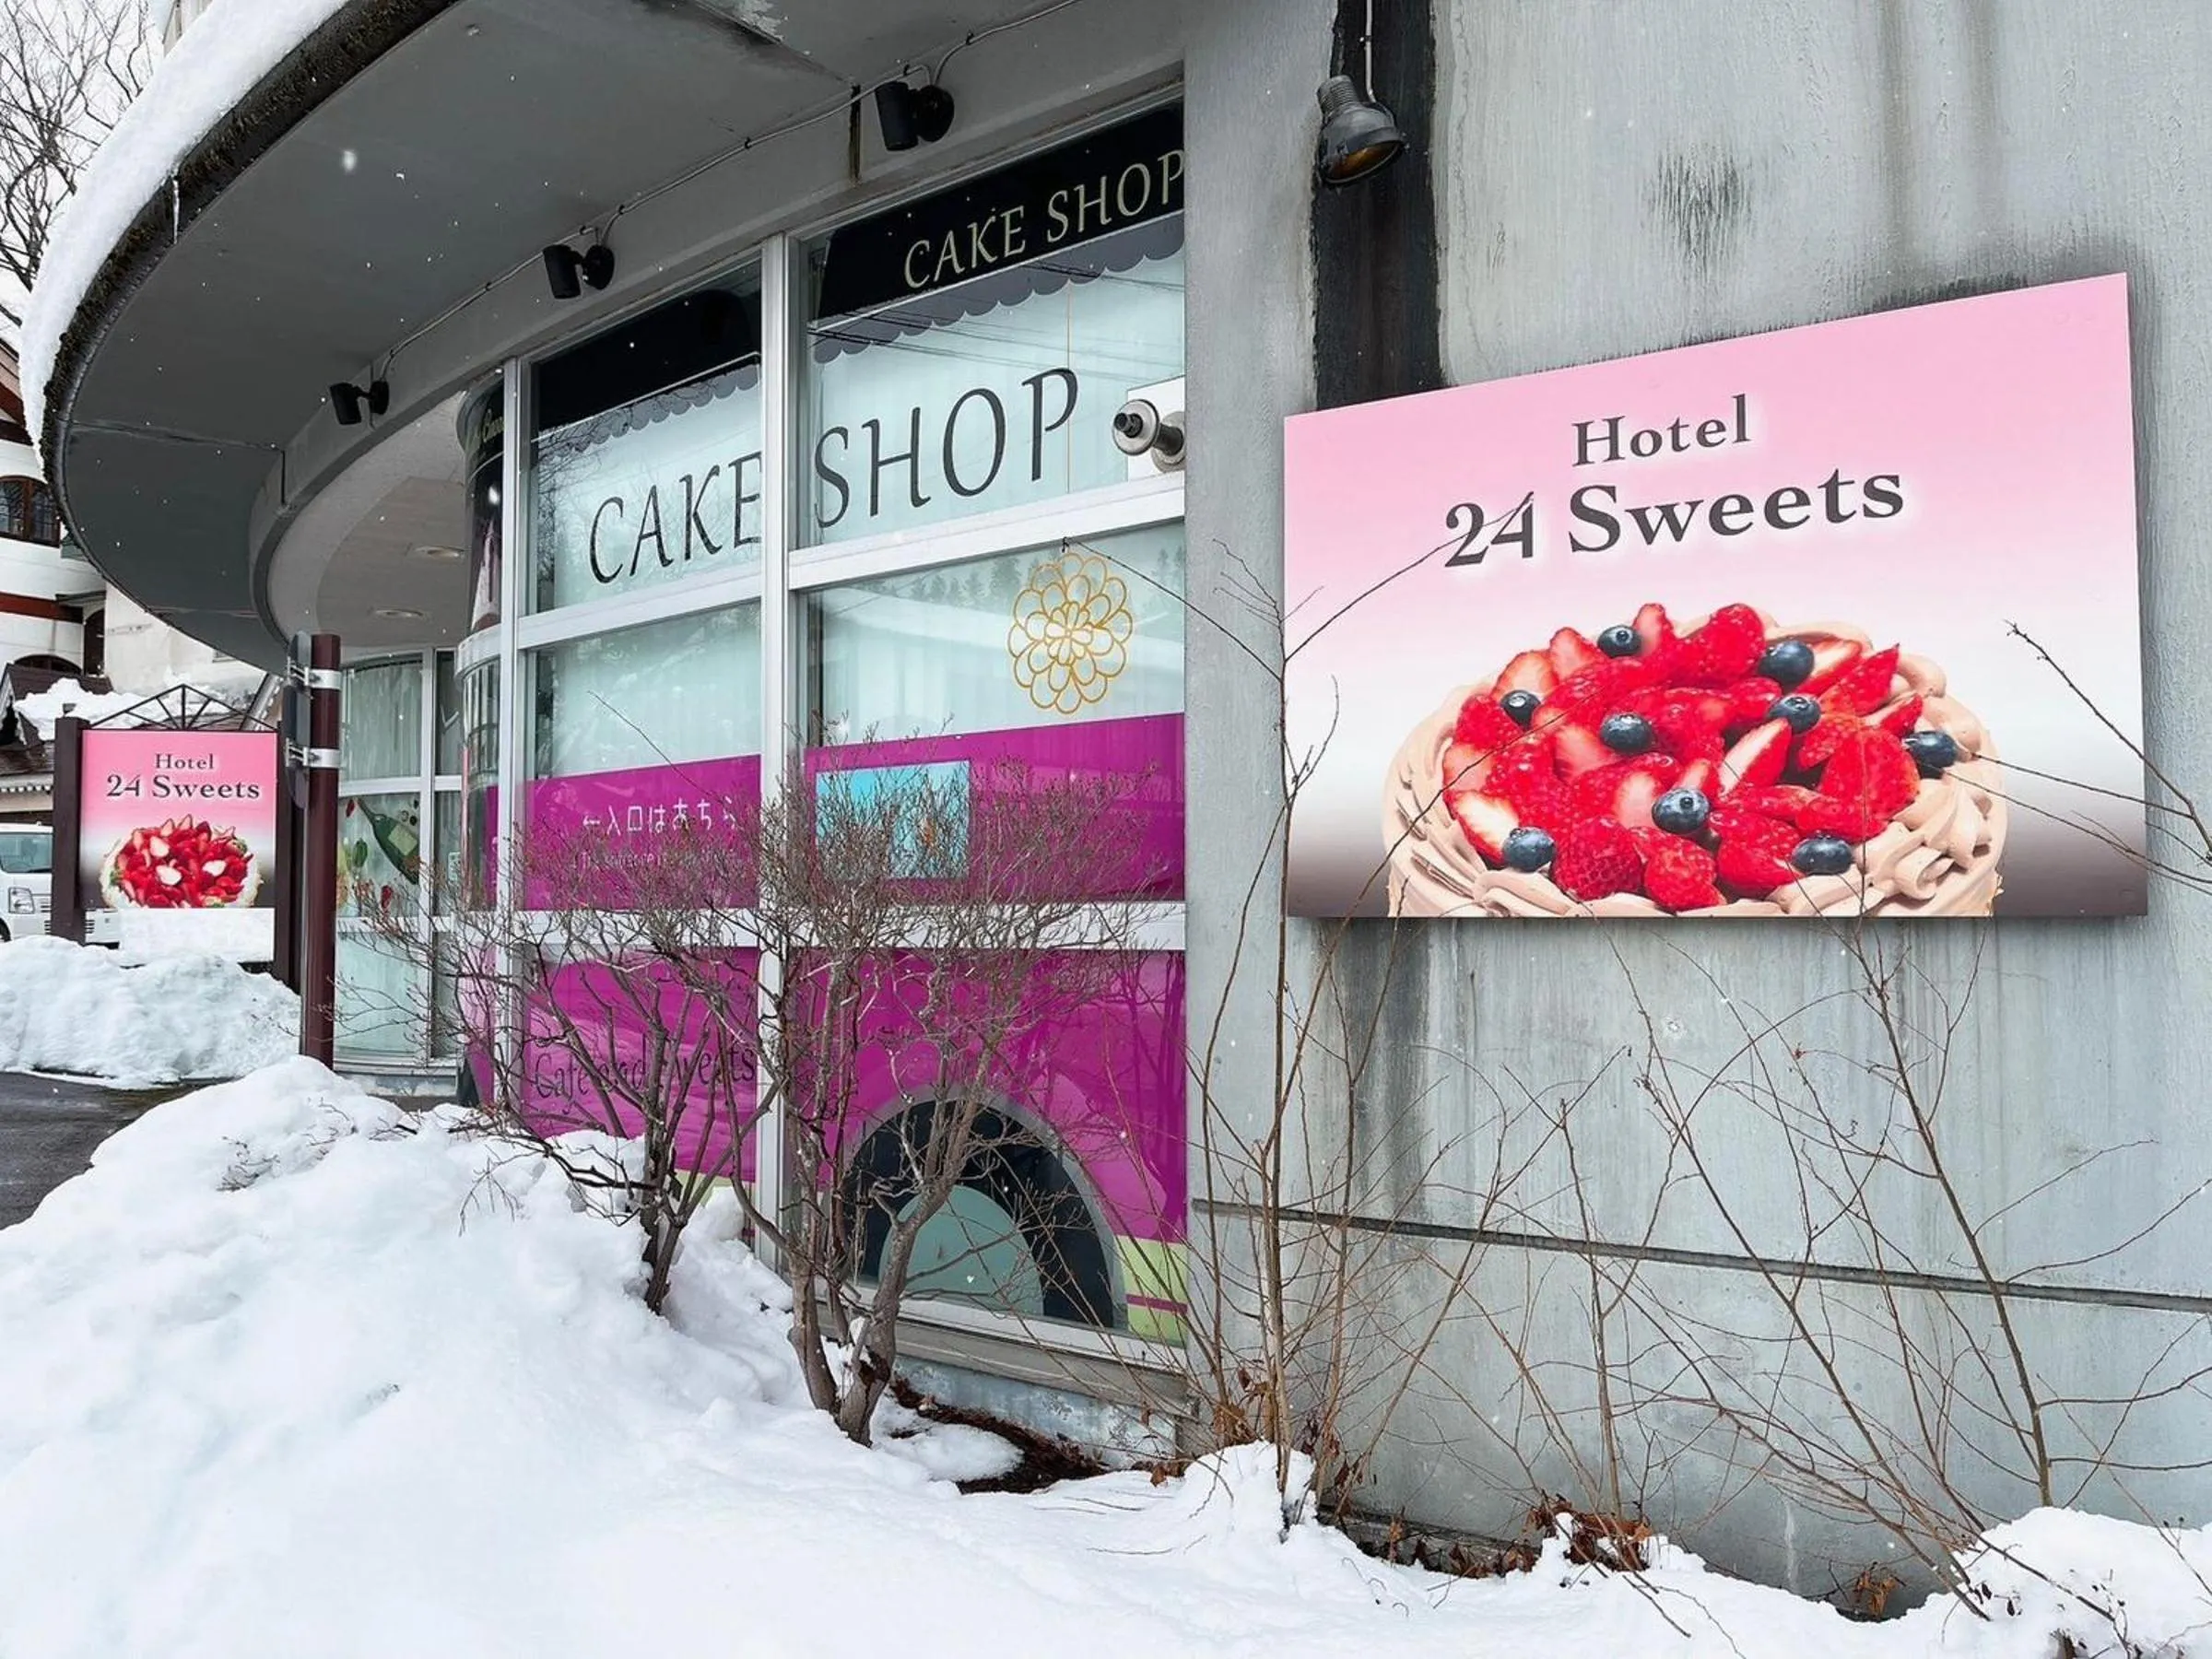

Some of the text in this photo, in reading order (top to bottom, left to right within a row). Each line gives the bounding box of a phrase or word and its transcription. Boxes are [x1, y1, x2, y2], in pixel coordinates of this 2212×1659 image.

[904, 148, 1184, 289] CAKE SHOP
[1571, 393, 1751, 467] Hotel
[589, 367, 1079, 585] CAKE SHOP
[1444, 467, 1904, 568] 24 Sweets
[106, 774, 260, 799] 24 Sweets
[155, 752, 215, 770] Hotel
